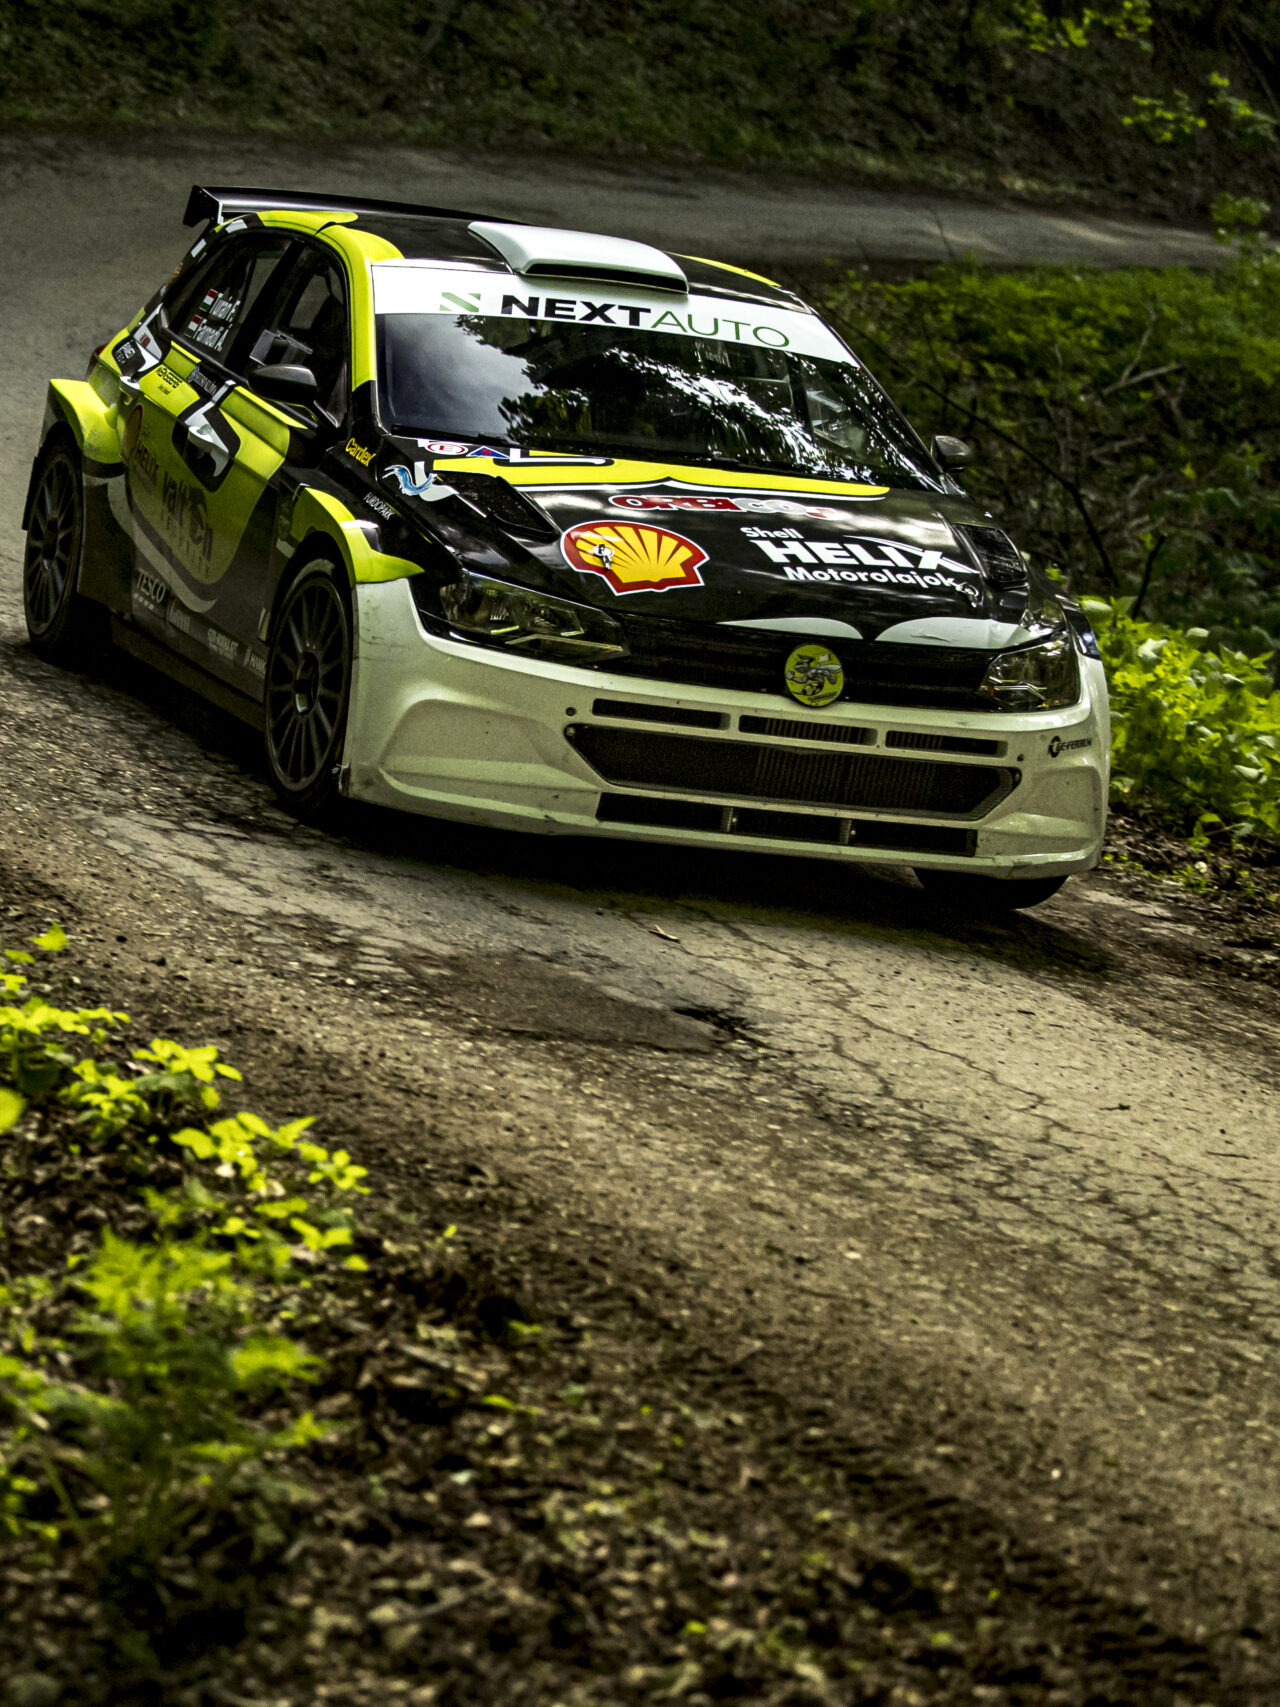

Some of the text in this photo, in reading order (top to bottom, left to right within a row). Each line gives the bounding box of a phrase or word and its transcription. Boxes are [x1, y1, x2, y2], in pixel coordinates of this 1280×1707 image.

[501, 294, 791, 348] NEXTAUTO
[345, 437, 377, 467] Cardex
[740, 526, 805, 540] Shell
[750, 537, 979, 574] HELIX
[136, 567, 166, 604] TESCO
[782, 565, 960, 589] Motorolajok
